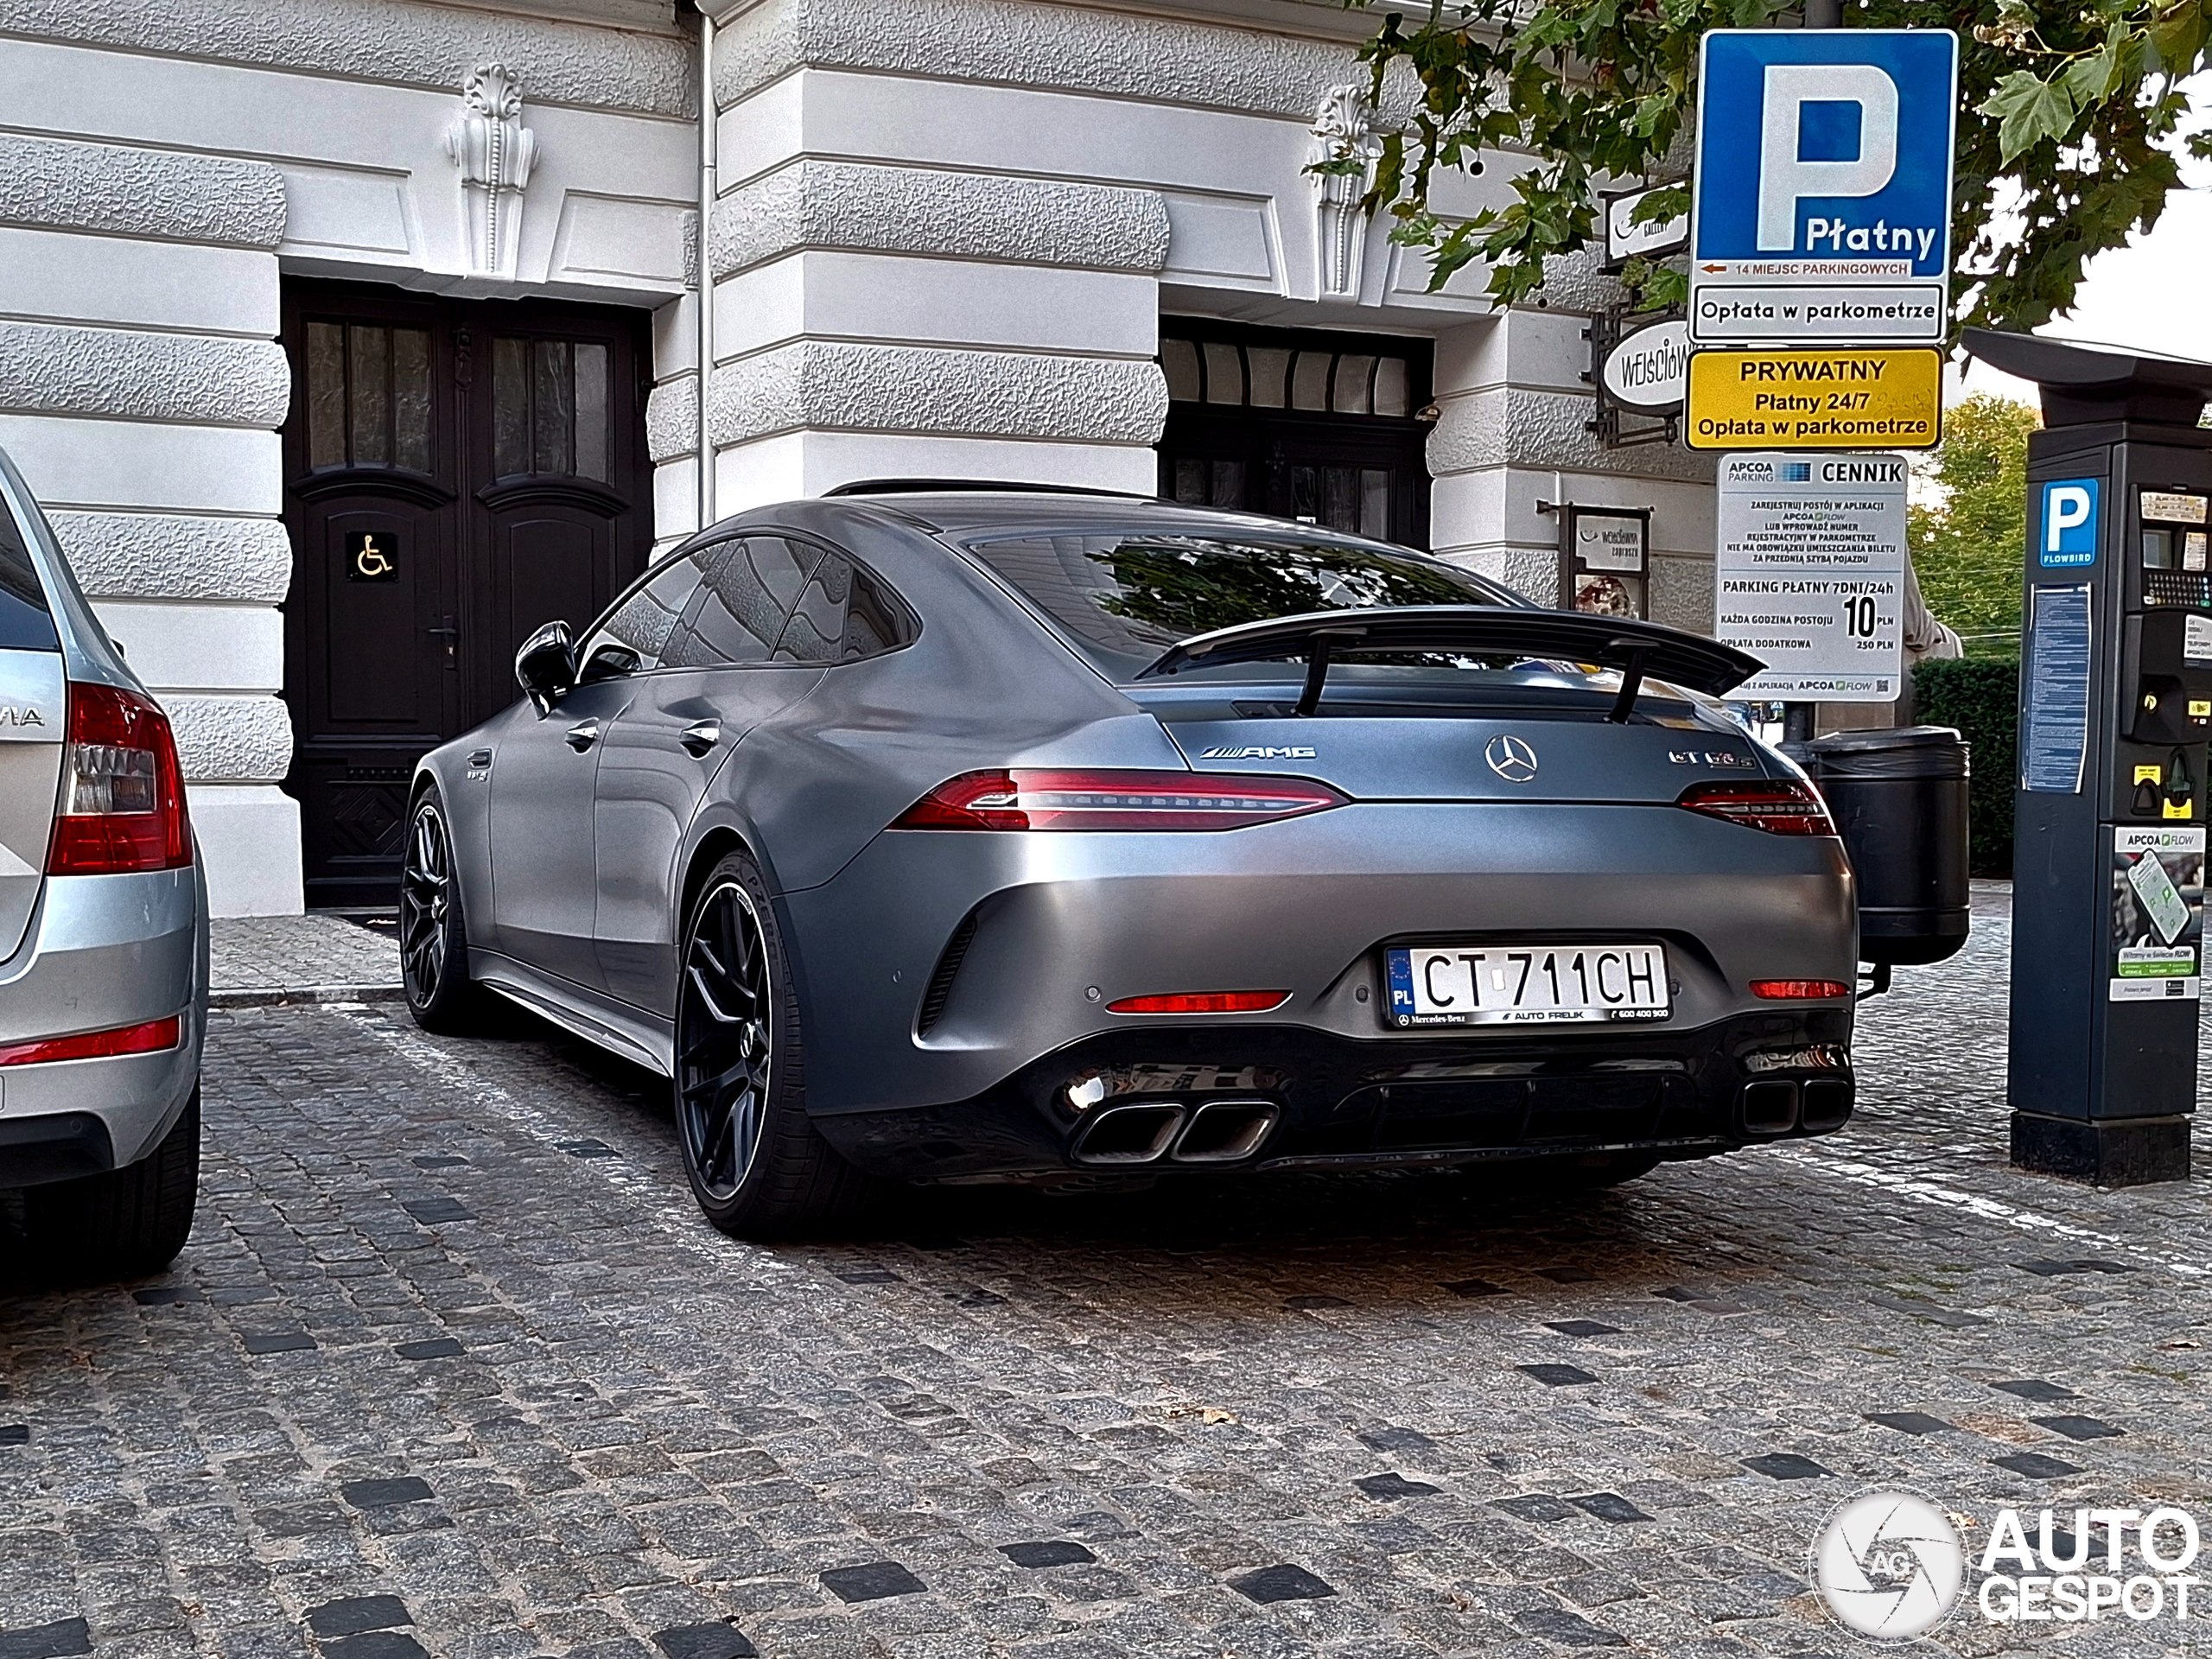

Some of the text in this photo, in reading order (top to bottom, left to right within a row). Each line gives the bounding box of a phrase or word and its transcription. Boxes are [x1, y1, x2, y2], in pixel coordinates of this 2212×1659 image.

[1757, 65, 1898, 251] P
[1807, 219, 1936, 261] Płatny
[1736, 264, 1908, 275] 14 MIEJSC PARKINGOWYCH
[1701, 302, 1936, 323] Opłata w parkometrze
[1740, 360, 1886, 381] PRYWATNY
[1756, 393, 1821, 414] Płatny
[1827, 393, 1870, 410] 24/7
[1698, 418, 1928, 439] Opłata w parkometrze
[1728, 473, 1774, 482] PARKING
[1729, 462, 1903, 482] APCOA CENNIK
[1751, 501, 1802, 511] ZAREJESTRUJ
[1803, 499, 1833, 512] POSTÓJ
[1844, 502, 1885, 512] APLIKACJI
[2047, 486, 2090, 552] P
[1782, 521, 1828, 531] WPROWADŹ
[1746, 533, 1808, 543] REJESTRACYJNY
[1756, 543, 1804, 553] OBOWIĄZKU
[1807, 544, 1866, 553] UMIESZCZANIA
[1867, 544, 1896, 553] BILETU
[1765, 555, 1804, 564] PRZEDNIĄ
[1806, 555, 1831, 564] SZYBĄ
[1834, 556, 1868, 564] POJAZDU
[2044, 554, 2091, 563] FLOWBIRD
[1723, 581, 1893, 594] PARKING PŁATNY 7DNI/24h
[1720, 595, 1893, 638] KAŻDA GODZINA POSTOJU 10 PLN
[1720, 639, 1893, 650] OPŁATA DODATKOWA 250 PLN
[1758, 682, 1794, 691] APLIKACJĄ
[1798, 681, 1834, 690] APCOA
[1846, 682, 1872, 690] FLOW
[1238, 747, 1317, 760] AMG
[2127, 835, 2194, 846] APCOA FLOW
[1425, 951, 1656, 1007] CT 711CH
[1394, 990, 1412, 1005] PL
[1411, 1014, 1465, 1024] Mercedes-Benz
[1548, 1011, 1585, 1020] FRELIK
[1618, 1010, 1635, 1019] 600
[1653, 1009, 1669, 1018] 900
